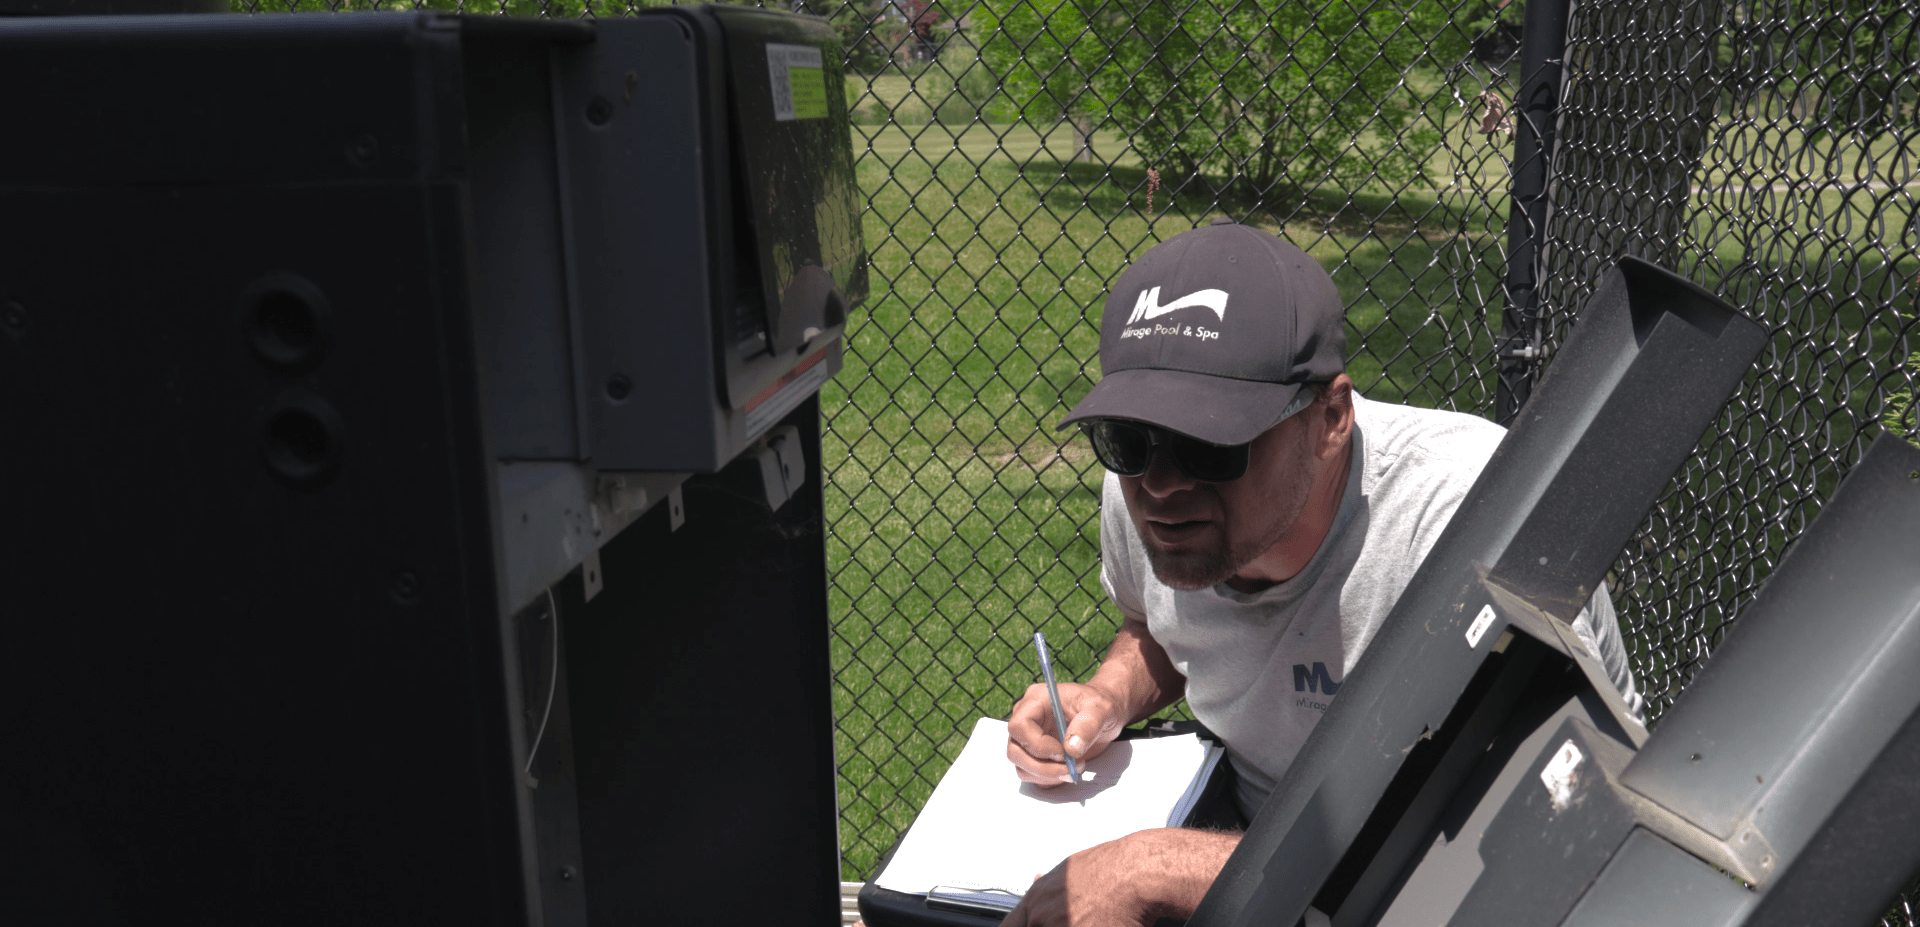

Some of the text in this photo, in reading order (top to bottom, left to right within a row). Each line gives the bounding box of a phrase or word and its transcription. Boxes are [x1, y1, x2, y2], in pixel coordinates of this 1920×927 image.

[1120, 323, 1220, 342] Mirage Pool & Spa
[1296, 697, 1327, 714] Mirag
